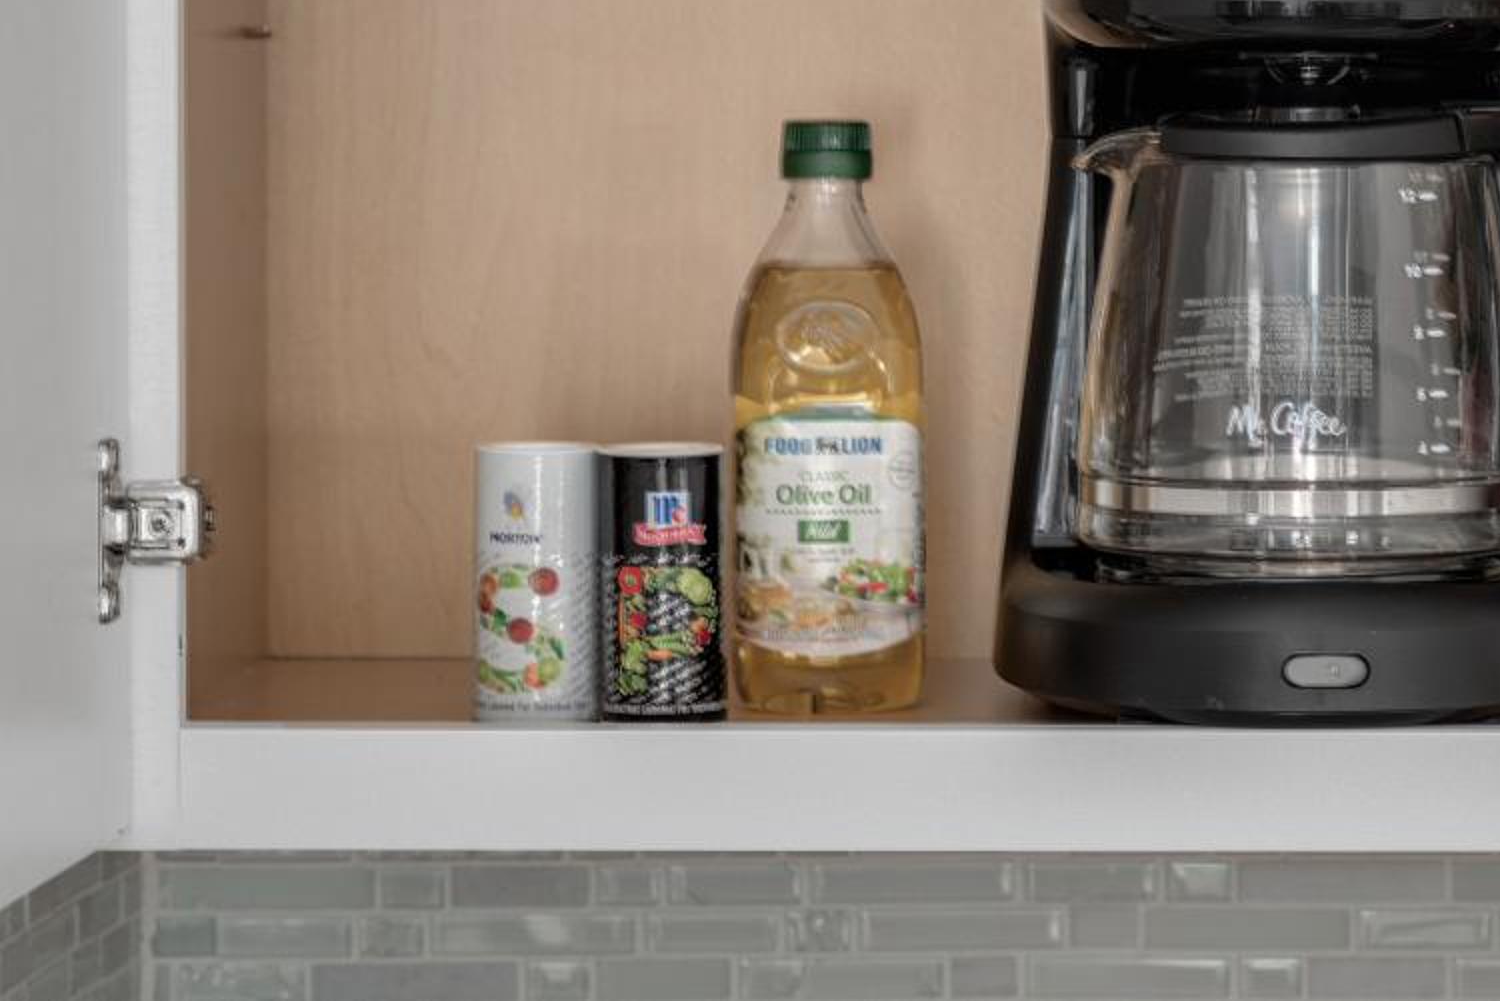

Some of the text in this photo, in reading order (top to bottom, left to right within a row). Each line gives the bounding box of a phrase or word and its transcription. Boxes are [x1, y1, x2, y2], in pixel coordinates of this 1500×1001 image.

[1399, 188, 1417, 203] 12
[1404, 264, 1423, 279] 10
[1270, 402, 1347, 450] Coffee
[841, 436, 883, 455] LION
[775, 483, 872, 506] Olive Oil
